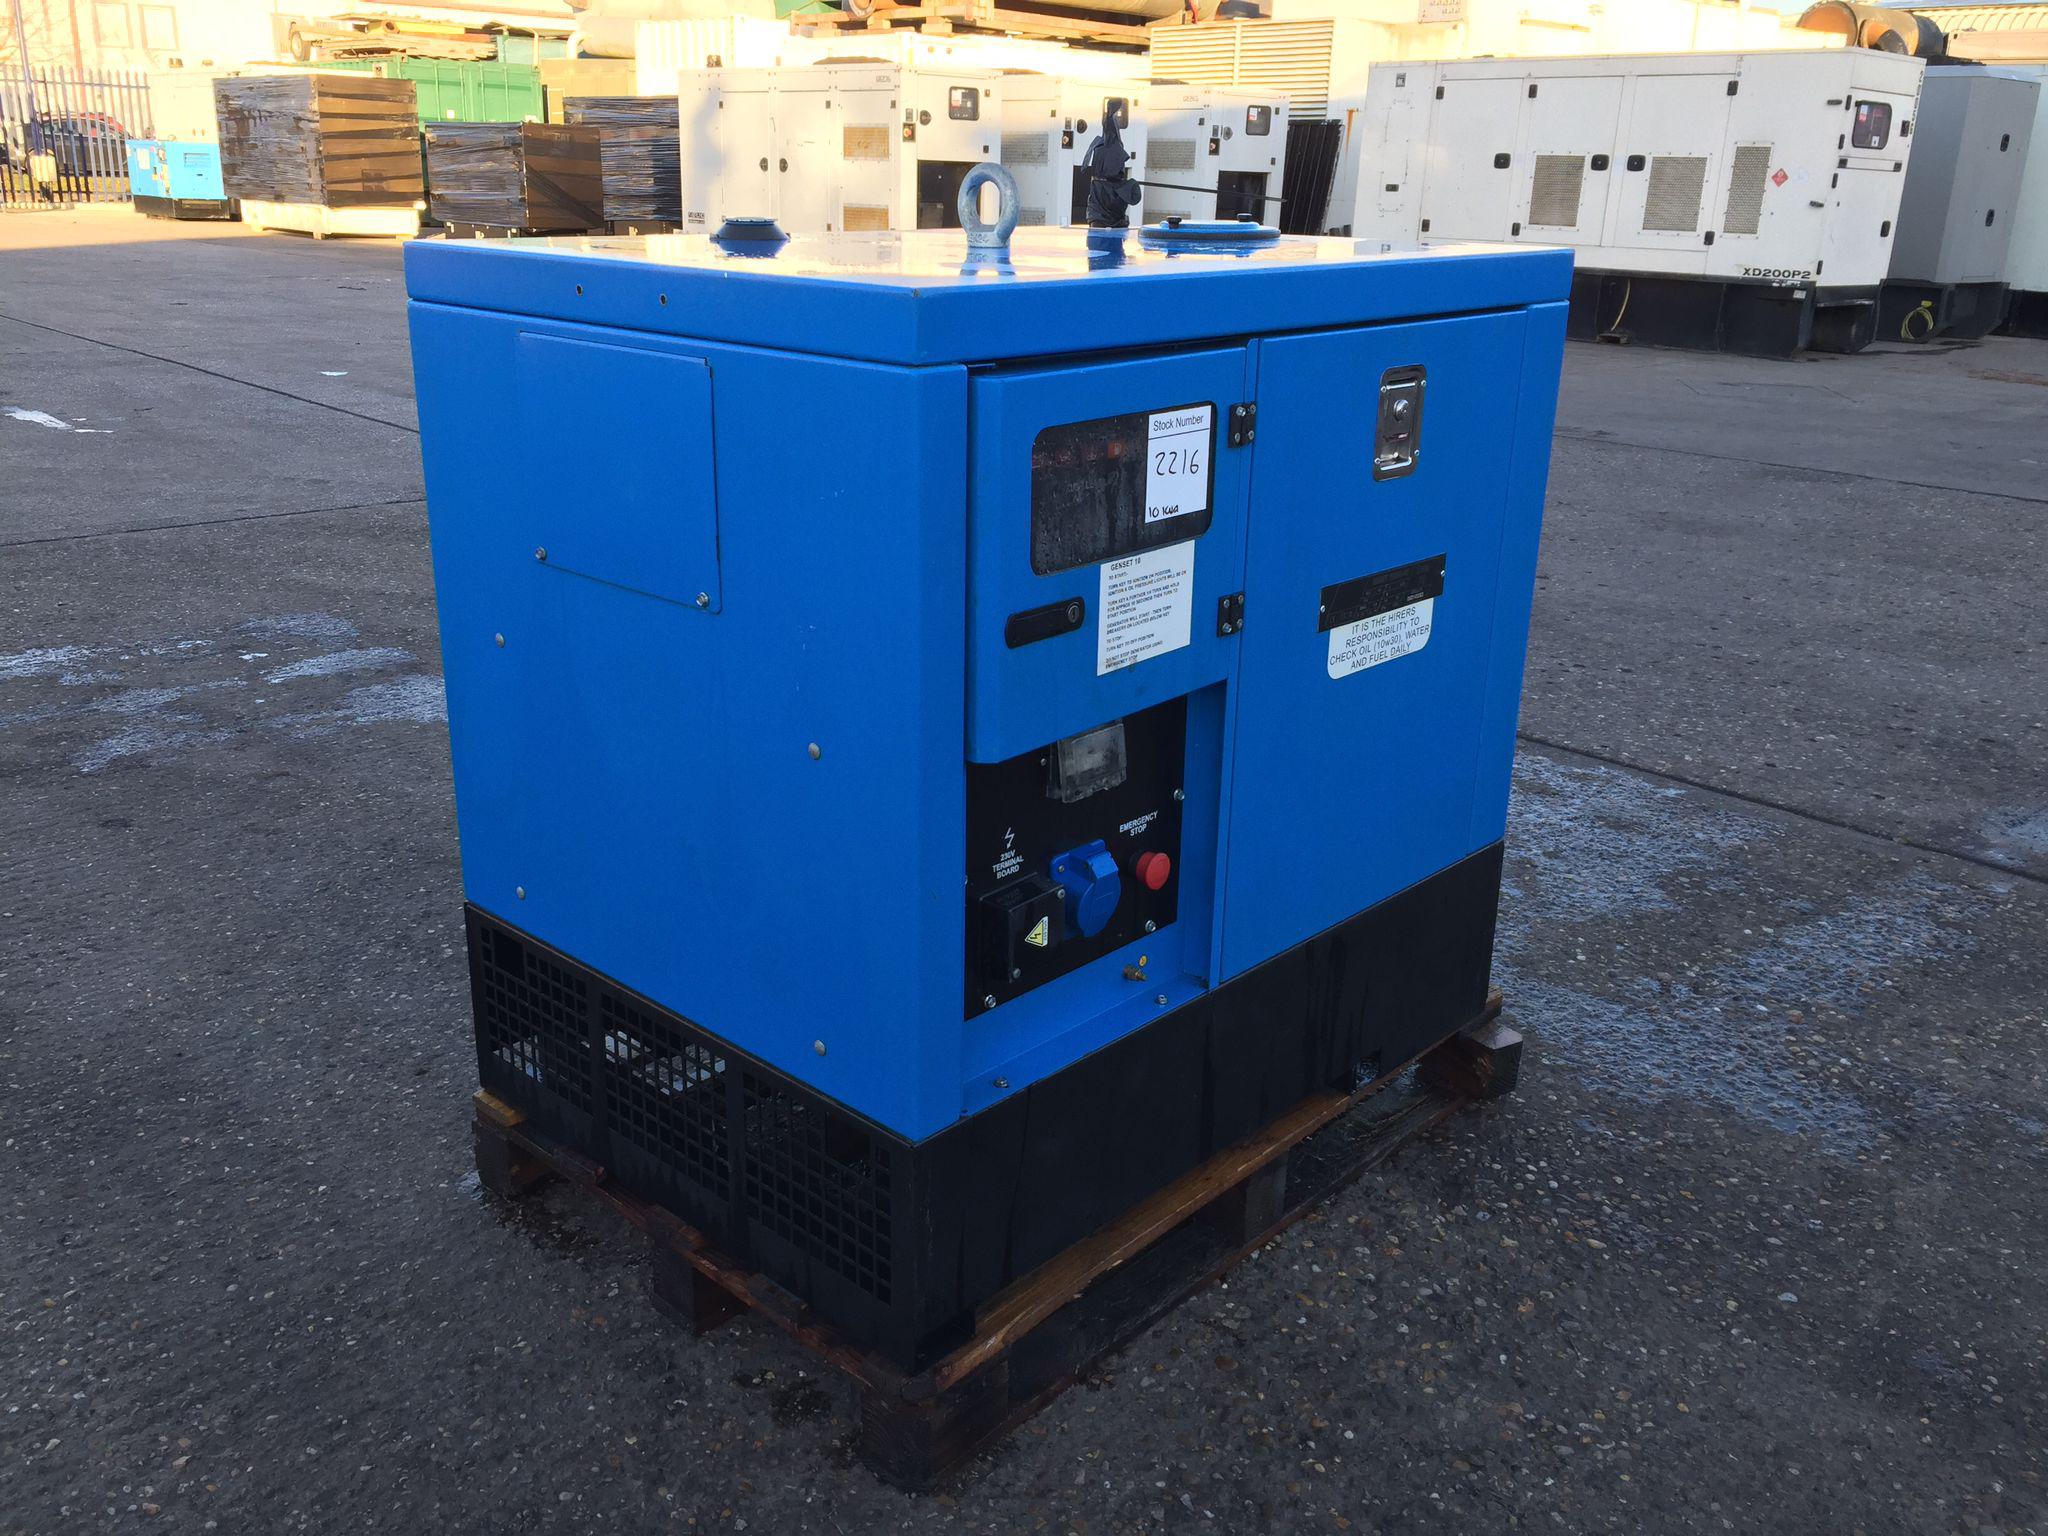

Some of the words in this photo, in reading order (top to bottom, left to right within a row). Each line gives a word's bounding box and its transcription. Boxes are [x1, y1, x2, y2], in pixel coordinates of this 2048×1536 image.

[1742, 267, 1812, 280] XD200P2
[1153, 418, 1174, 432] Stock
[1175, 414, 1204, 428] Number
[1155, 448, 1200, 476] 2216
[1148, 506, 1160, 518] 10
[1352, 624, 1360, 635] IT
[1361, 622, 1369, 632] IS
[1371, 616, 1386, 628] THE
[1388, 606, 1416, 622] HIRERS
[1346, 622, 1408, 648] RESPONSIBILITY
[1410, 616, 1420, 628] TO
[1330, 648, 1358, 666] CHECK
[1358, 644, 1372, 656] OIL
[1405, 624, 1430, 640] WATER
[1350, 656, 1368, 670] AND
[1368, 650, 1388, 664] FUEL
[1390, 641, 1412, 656] DAILY
[1119, 810, 1158, 833] EMERGENCY
[1130, 823, 1147, 837] STOP
[992, 854, 1024, 873] TERMINAL
[996, 864, 1020, 880] BOARD
